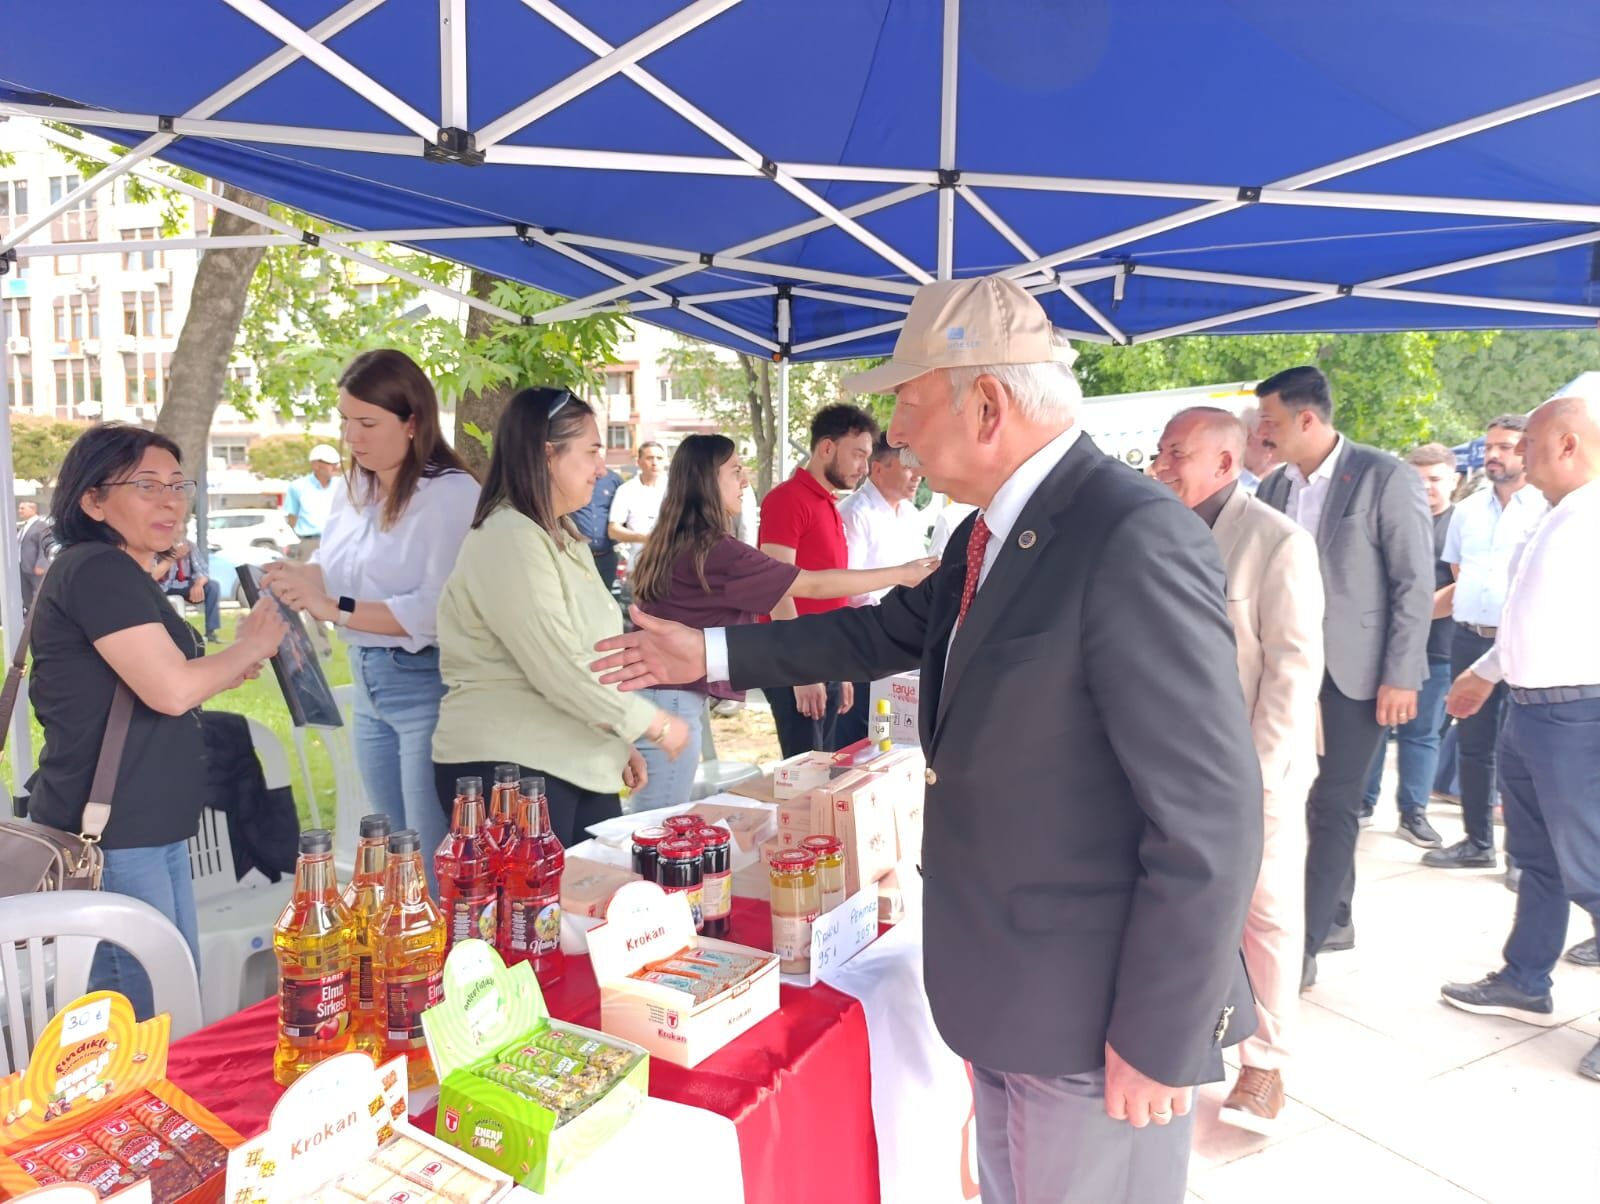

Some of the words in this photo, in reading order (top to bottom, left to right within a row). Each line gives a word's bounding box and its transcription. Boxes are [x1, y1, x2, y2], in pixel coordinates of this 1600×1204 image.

[625, 925, 665, 951] Krokan
[321, 983, 344, 1001] Elma
[427, 983, 443, 998] Elm
[316, 995, 347, 1018] Sirkesi
[657, 1028, 688, 1044] Krokan
[290, 1111, 357, 1161] Krokan
